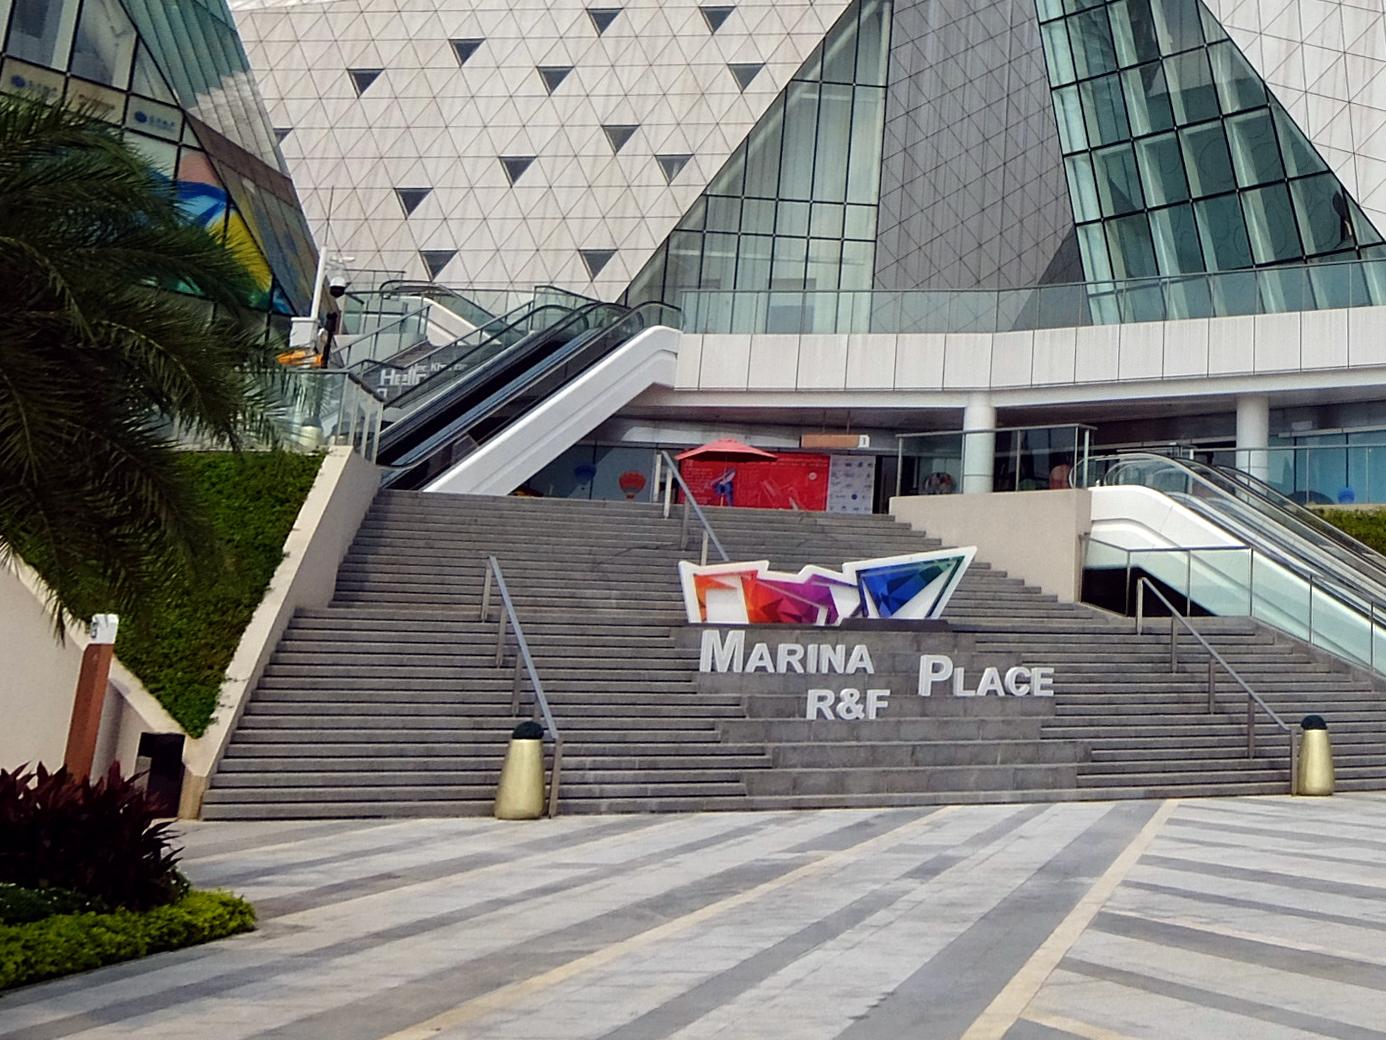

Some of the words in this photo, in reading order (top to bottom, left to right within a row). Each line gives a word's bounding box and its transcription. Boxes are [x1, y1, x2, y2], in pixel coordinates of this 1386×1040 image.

[700, 629, 875, 674] MARINA
[918, 655, 1055, 697] PLACE
[806, 688, 890, 720] R&F
